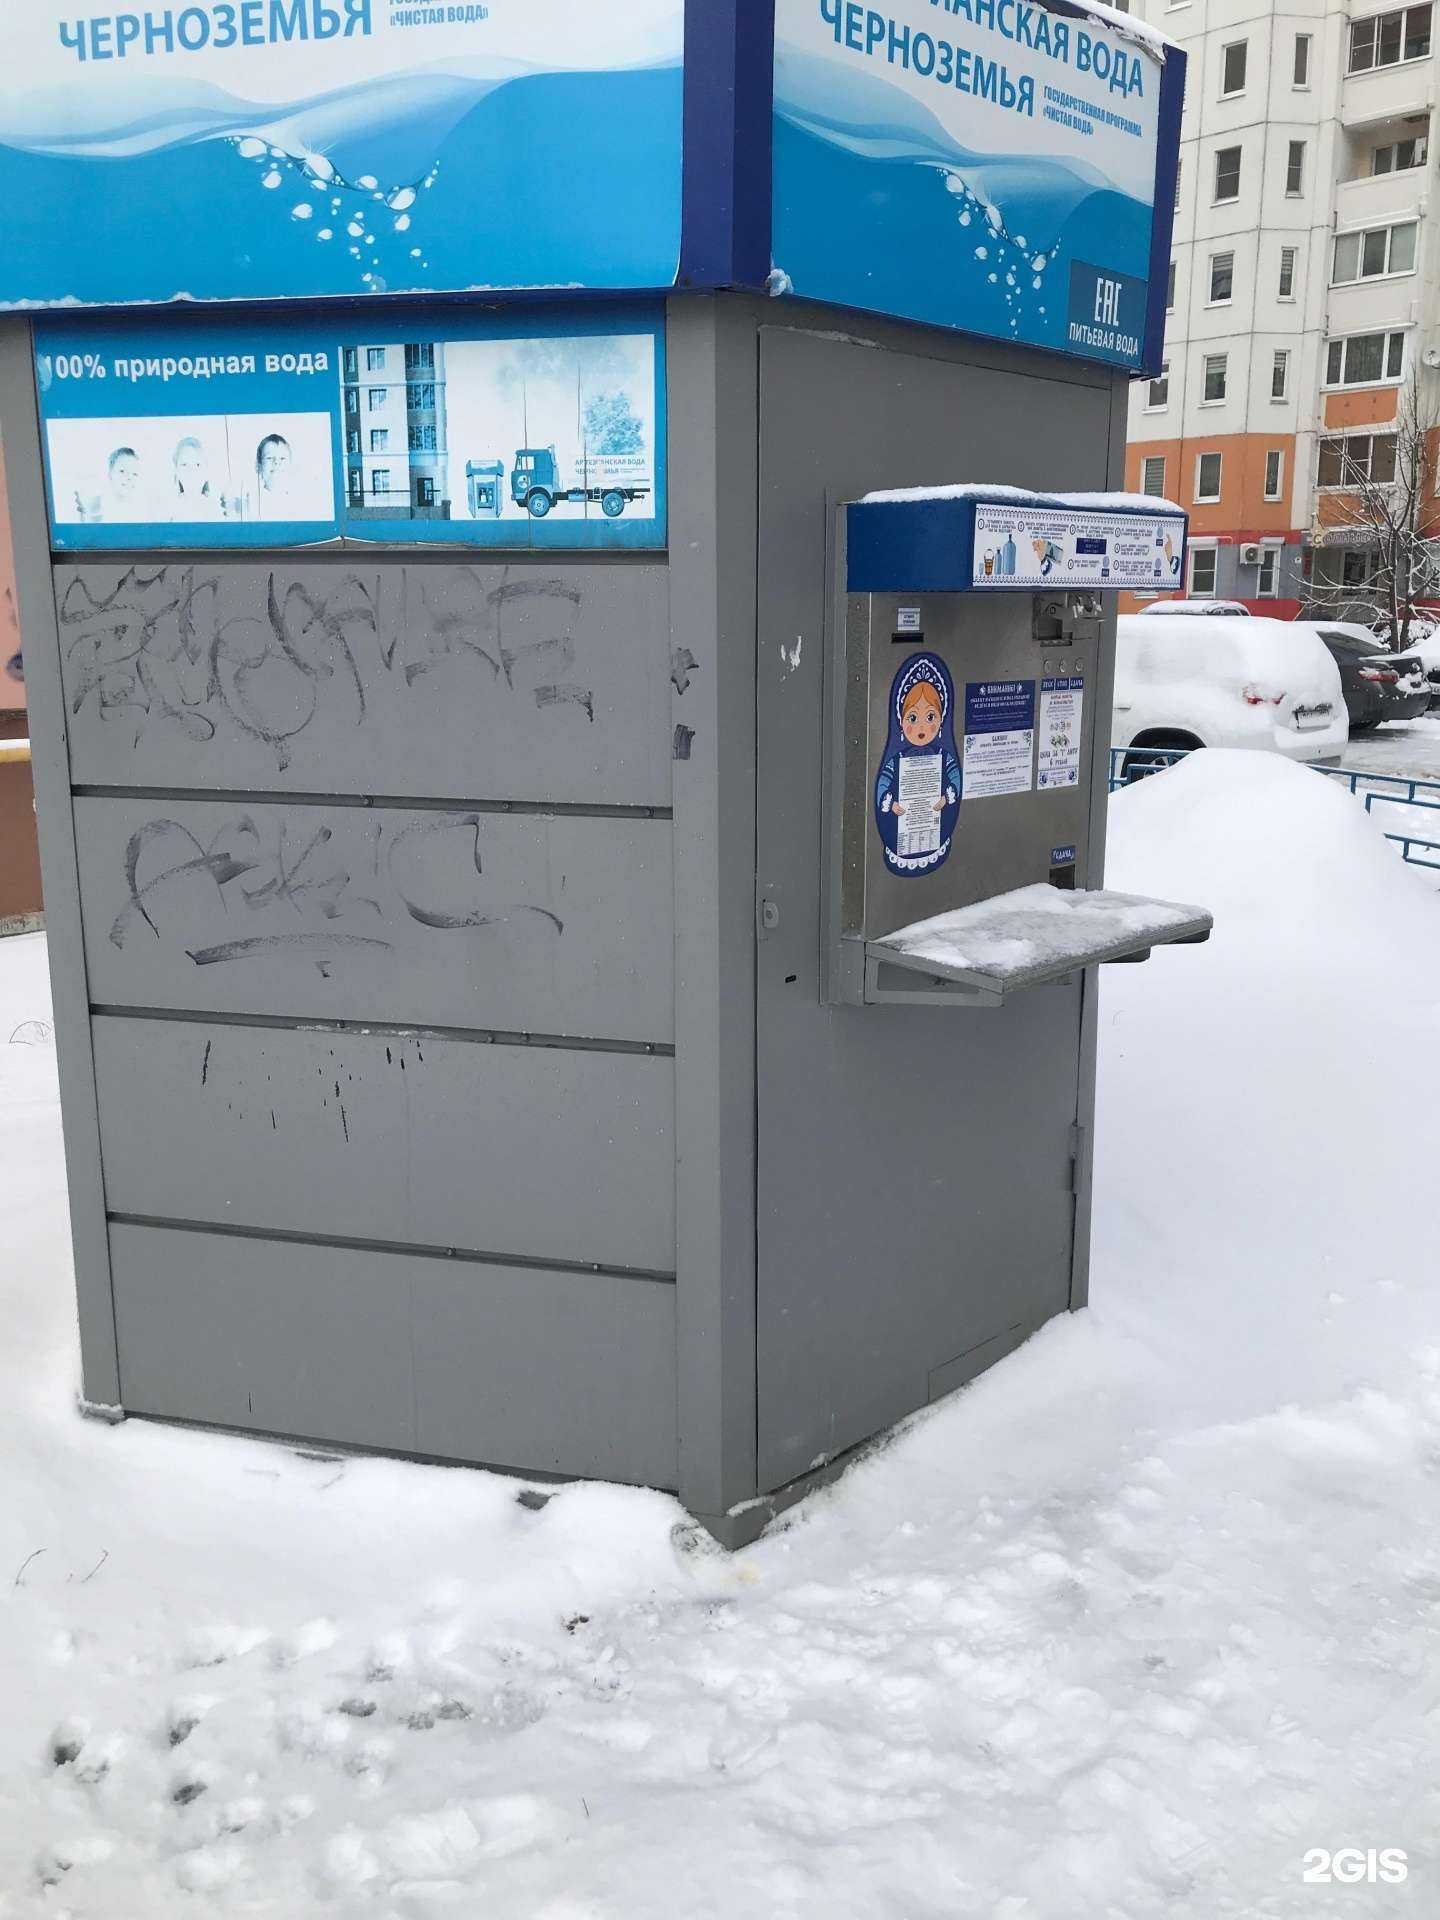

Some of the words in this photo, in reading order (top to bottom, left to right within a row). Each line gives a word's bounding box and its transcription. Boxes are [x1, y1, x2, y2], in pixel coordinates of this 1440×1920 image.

[60, 0, 373, 61] ЧЕРНОЗЕМЬЯ
[390, 8, 444, 26] «ЧИСТАЯ
[447, 5, 489, 23] ВОДА»
[820, 0, 1035, 117] ЧЕРНОЗЕМЬЯ
[1077, 31, 1143, 98] ВОДА
[1044, 85, 1105, 122] ГОСУДАРСТВЕННАЯ
[1105, 110, 1143, 137] ПРОГРАММА
[1069, 322, 1115, 350] ПИТЬЕВАЯ
[1115, 333, 1139, 358] ВОДА
[43, 354, 106, 379] 100%
[115, 354, 256, 382] природная
[265, 352, 329, 375] вода
